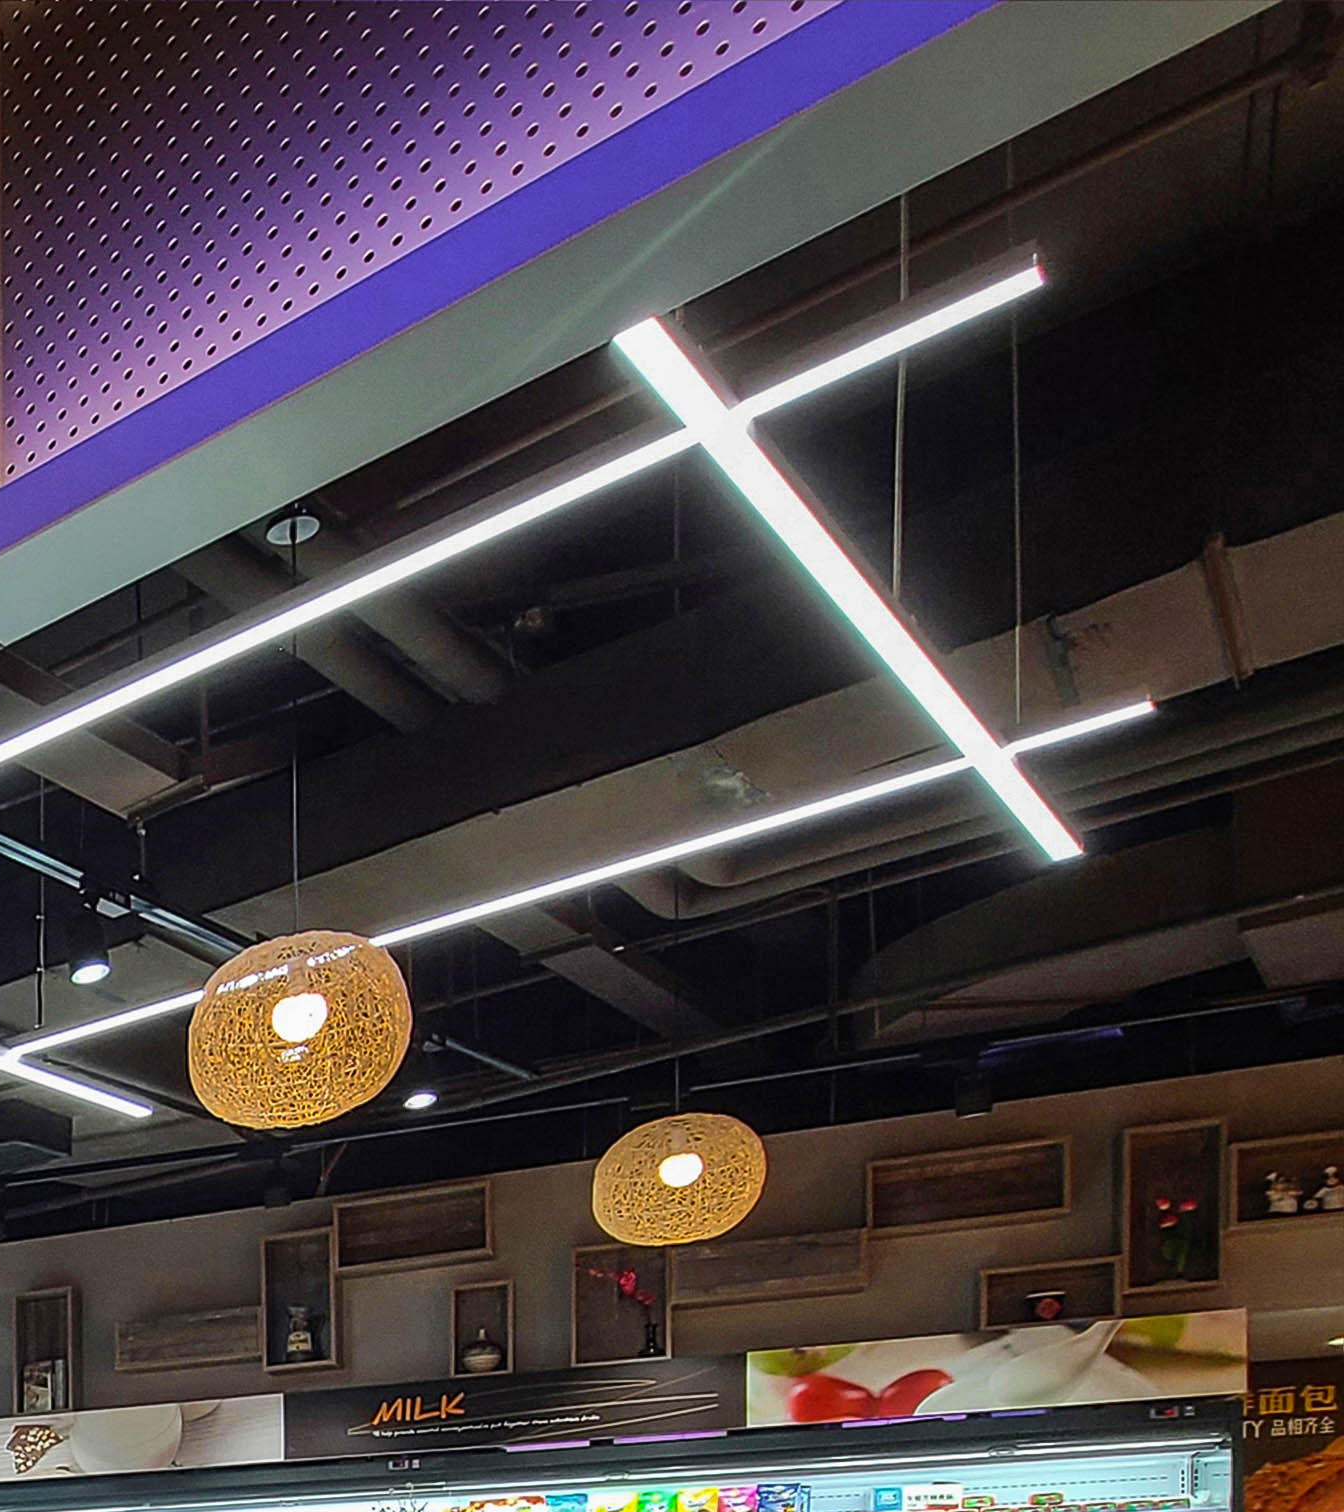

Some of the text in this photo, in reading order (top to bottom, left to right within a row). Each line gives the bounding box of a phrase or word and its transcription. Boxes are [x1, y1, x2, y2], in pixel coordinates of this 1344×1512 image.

[371, 1392, 465, 1425] MILK
[1271, 1416, 1335, 1437] 品相齐全
